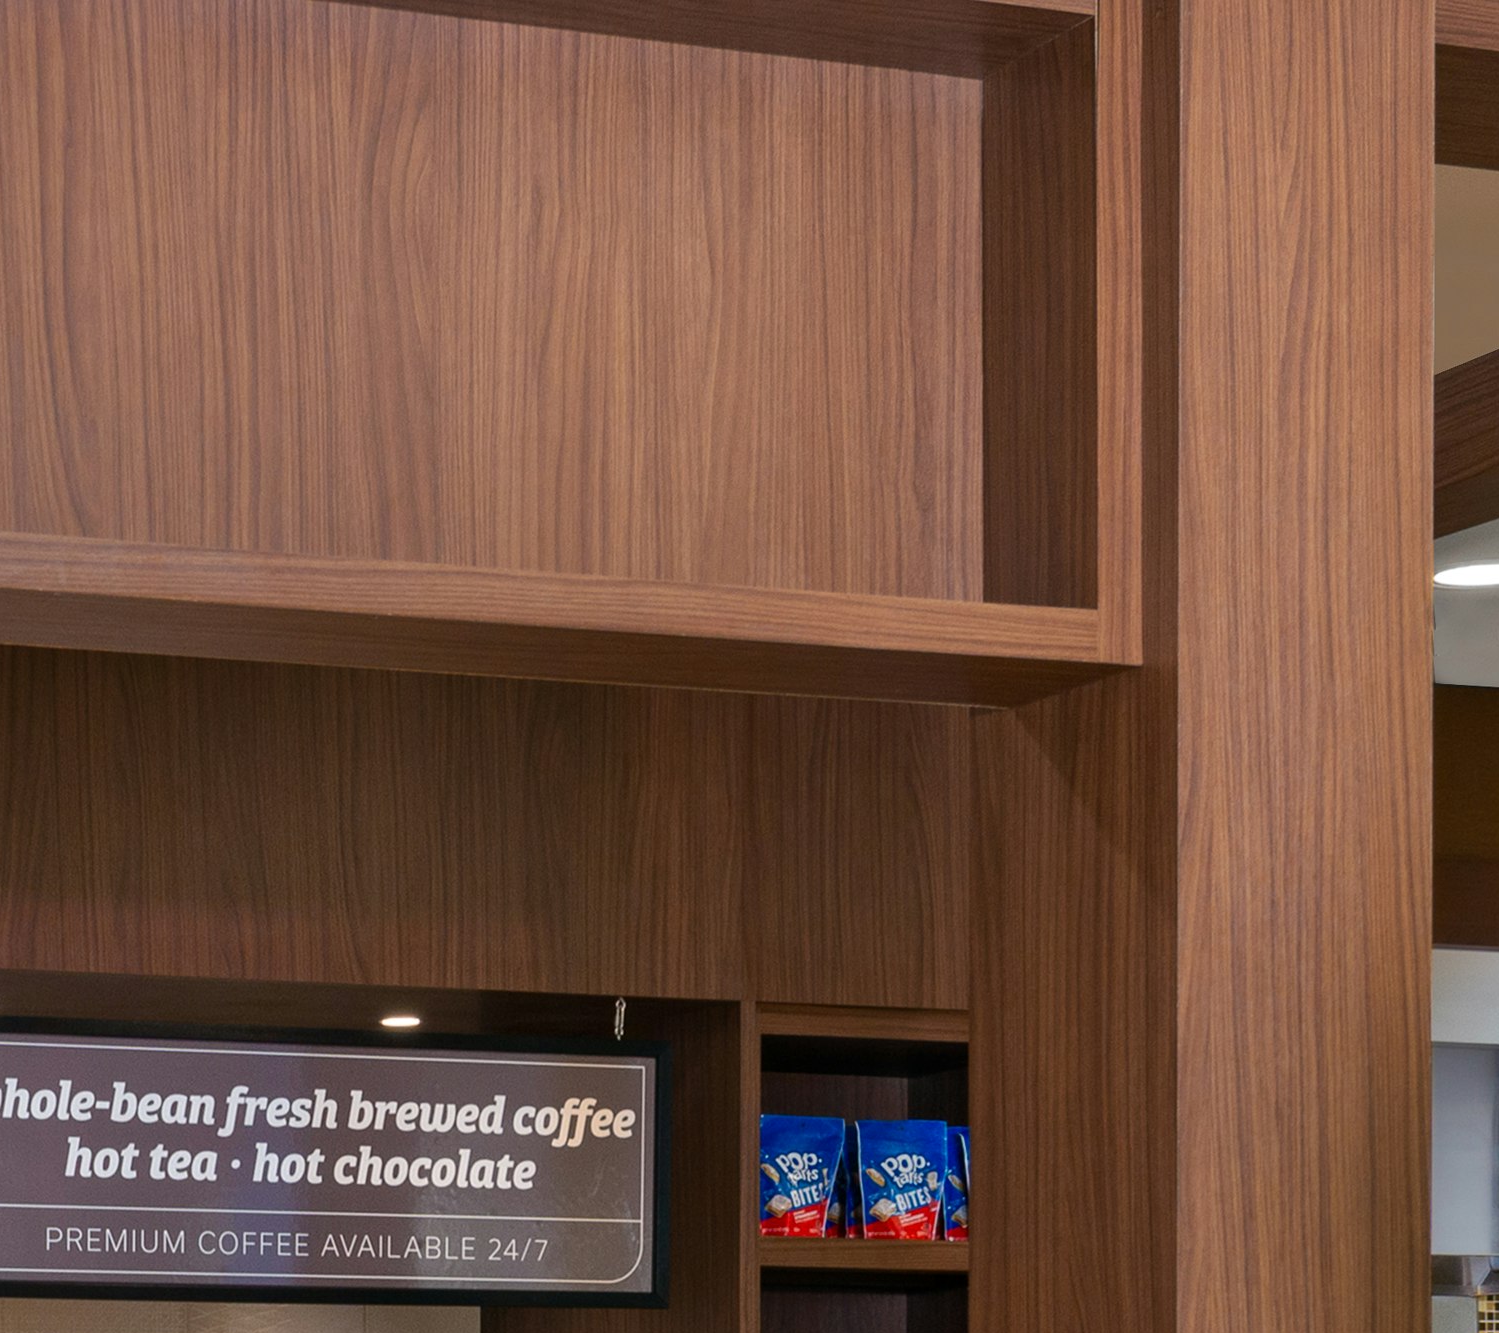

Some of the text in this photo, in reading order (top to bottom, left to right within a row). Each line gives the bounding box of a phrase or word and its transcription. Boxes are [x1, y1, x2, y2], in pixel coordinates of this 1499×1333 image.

[220, 1085, 338, 1137] fresh
[348, 1090, 507, 1135] brewed
[513, 1098, 635, 1148] coffee
[65, 1138, 537, 1191] hot tea hot chocolate
[895, 1187, 931, 1211] BITES
[45, 1227, 549, 1262] PREMIUM COFFEE AVAILABLE 24/7
